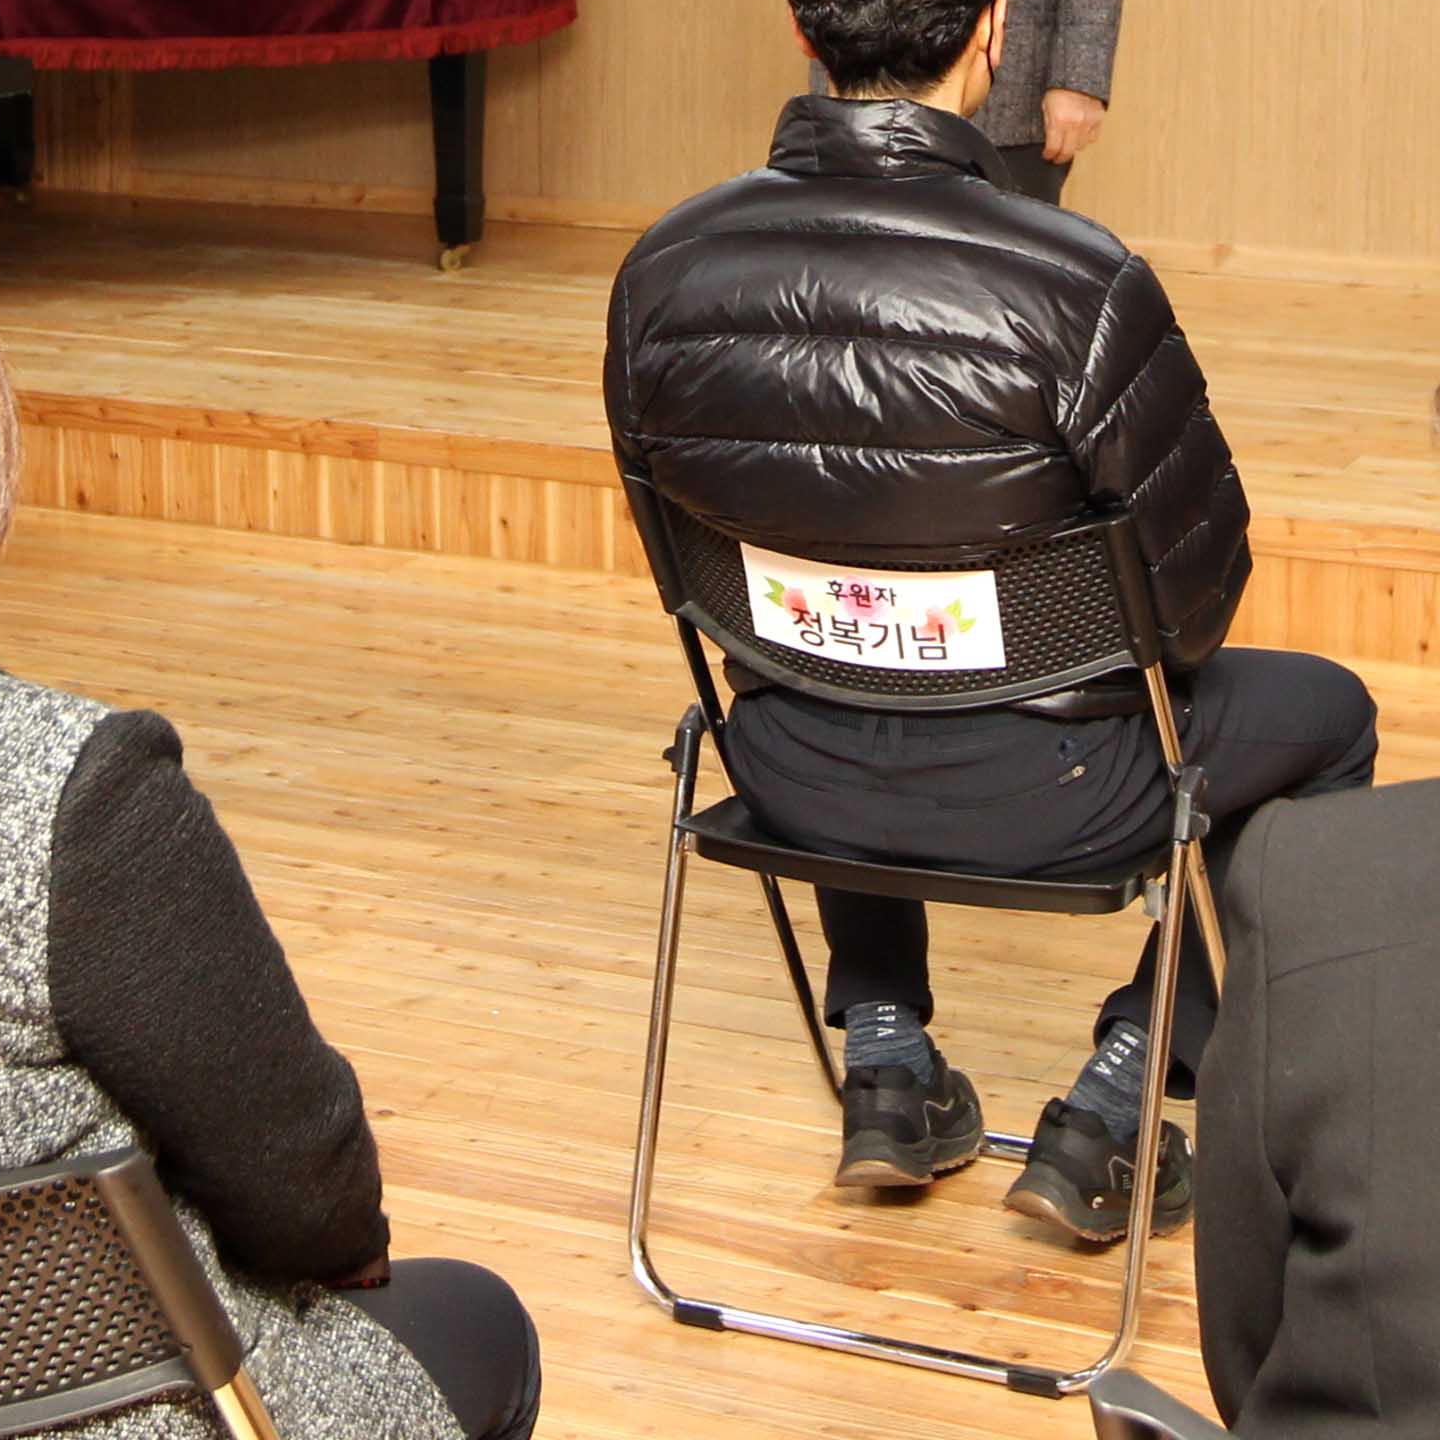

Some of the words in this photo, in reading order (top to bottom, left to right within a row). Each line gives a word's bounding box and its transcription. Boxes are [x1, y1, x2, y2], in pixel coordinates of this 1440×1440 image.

[826, 579, 897, 608] 후원자
[791, 607, 948, 661] 정복기님
[877, 1004, 897, 1037] EPA
